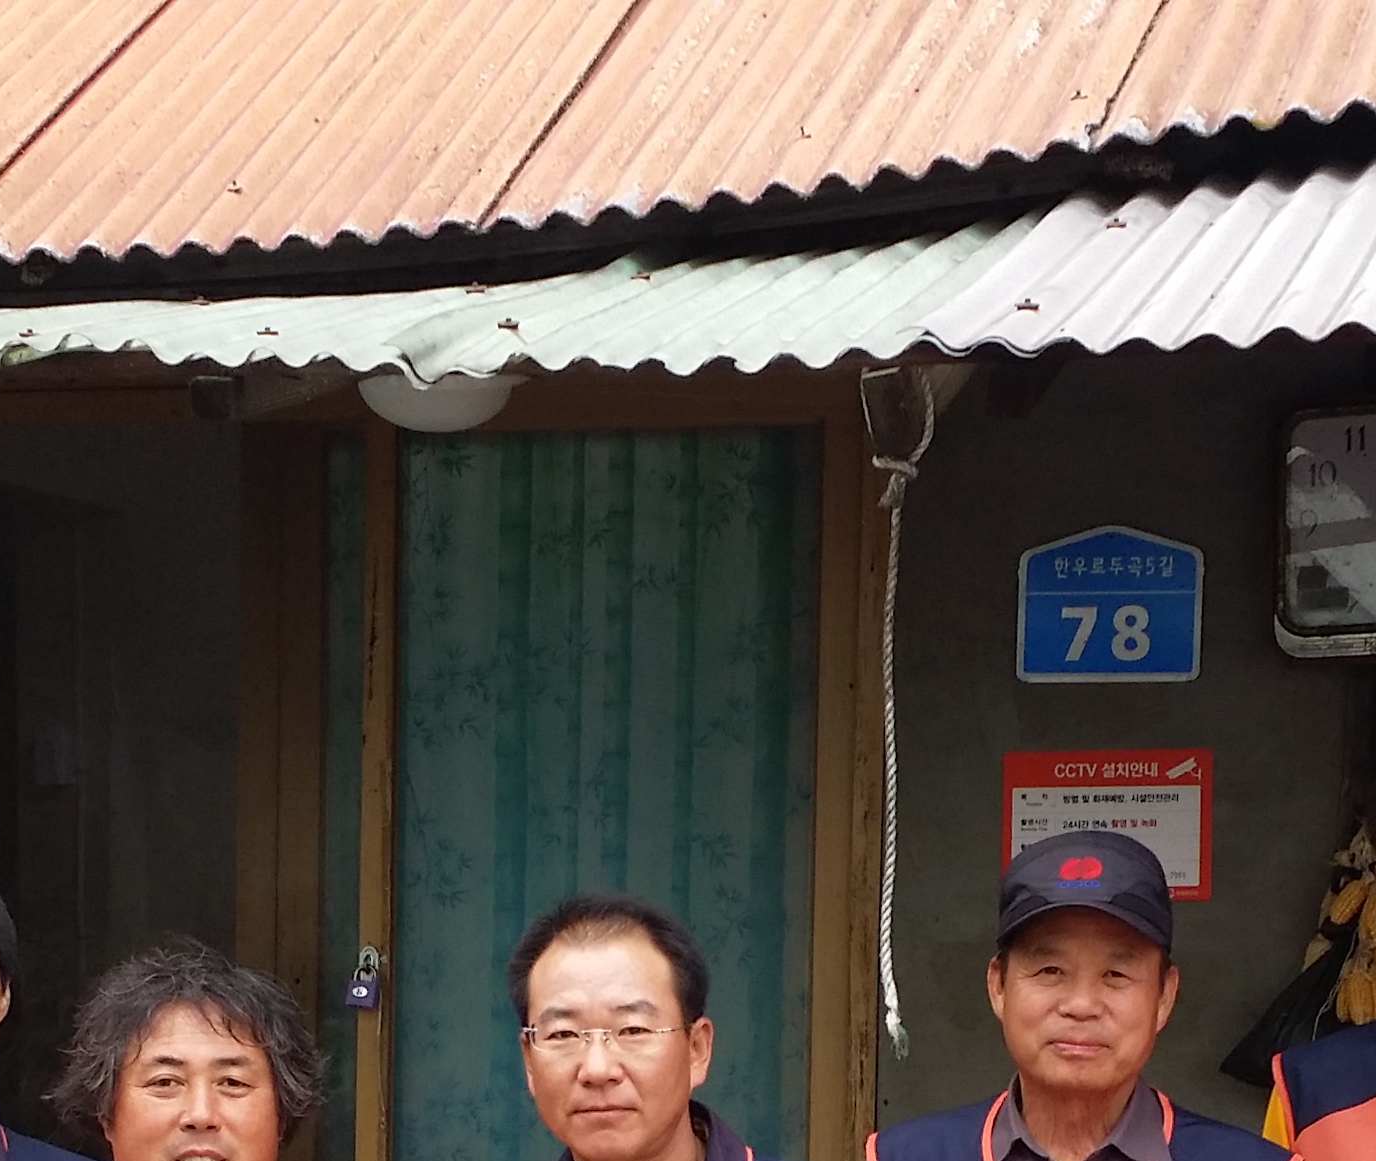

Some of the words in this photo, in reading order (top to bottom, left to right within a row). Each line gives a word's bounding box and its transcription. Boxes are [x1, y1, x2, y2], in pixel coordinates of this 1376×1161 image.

[1344, 424, 1366, 453] 11
[1307, 460, 1338, 488] 10
[1299, 509, 1318, 538] 9
[1061, 605, 1151, 662] 78
[1054, 763, 1097, 779] CCTV
[1101, 762, 1159, 779] 설치안내
[1062, 820, 1089, 830] 24시간
